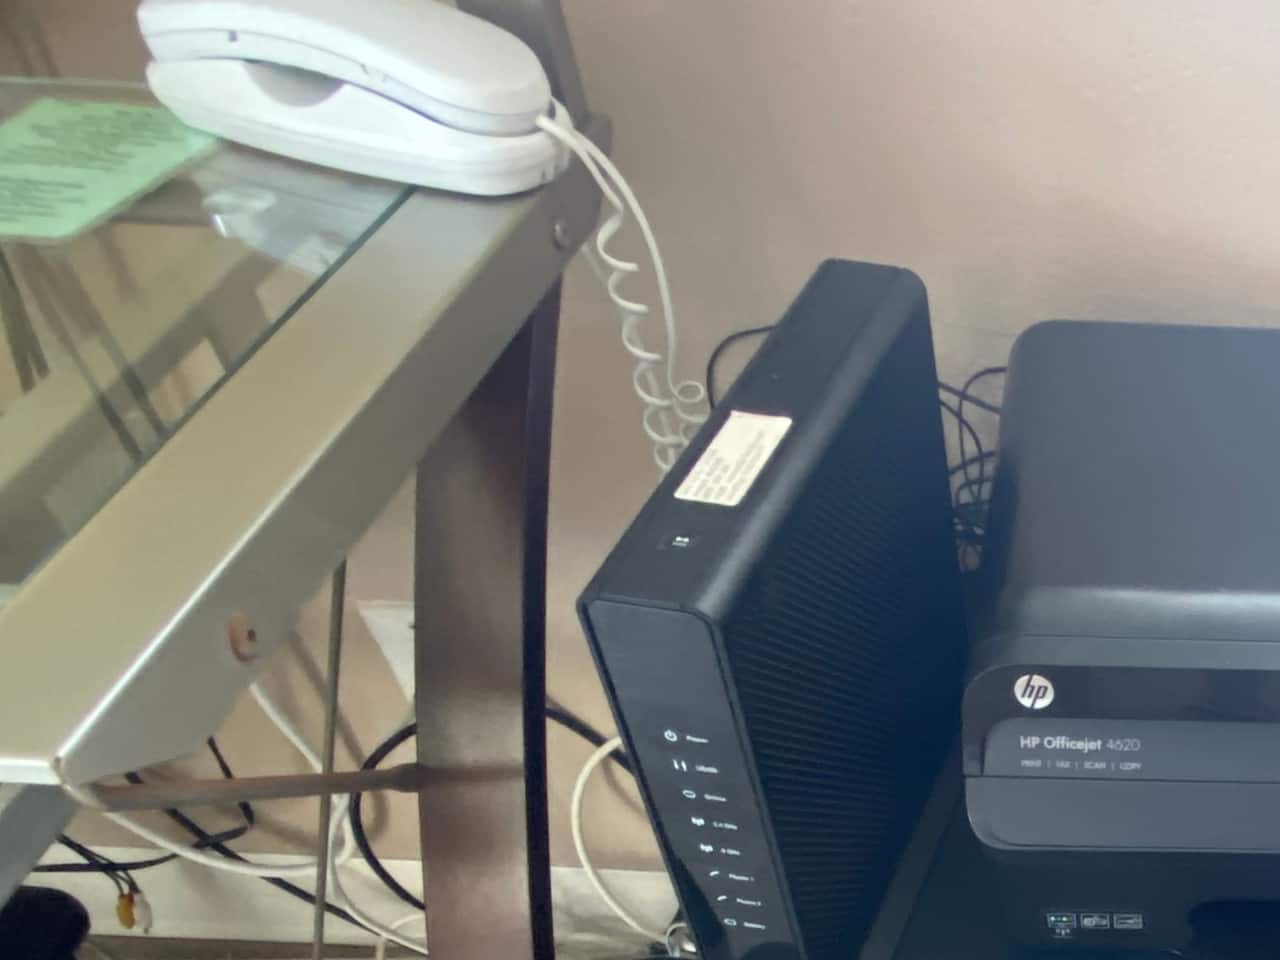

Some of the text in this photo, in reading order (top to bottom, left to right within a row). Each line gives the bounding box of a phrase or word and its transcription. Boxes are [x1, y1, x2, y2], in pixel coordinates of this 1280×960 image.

[1020, 735, 1141, 753] HP Officejet 4620
